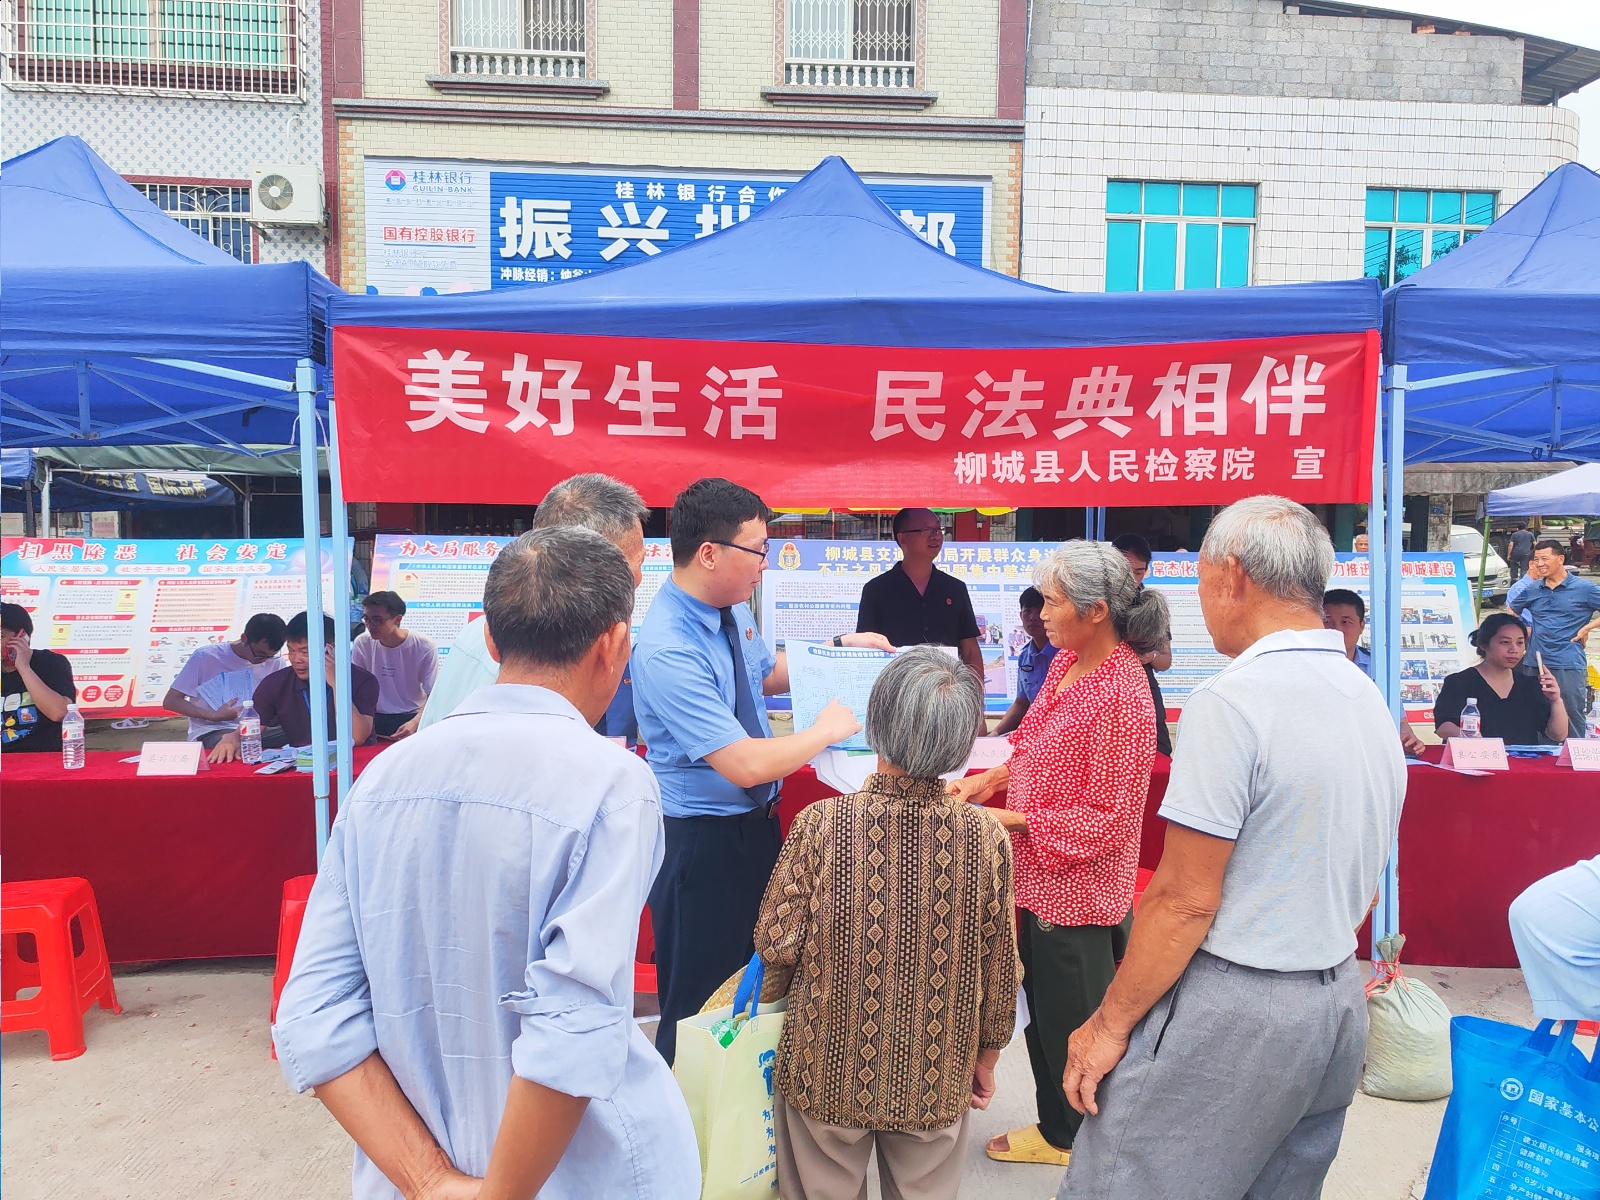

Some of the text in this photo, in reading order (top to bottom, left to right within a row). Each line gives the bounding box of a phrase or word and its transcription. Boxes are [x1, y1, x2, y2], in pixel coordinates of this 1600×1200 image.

[412, 170, 472, 185] 桂林银行
[412, 185, 473, 194] GUILIN BANK
[383, 226, 476, 243] 国有控股银行
[405, 348, 1326, 442] 美好生活 民法典相伴
[953, 446, 1325, 486] 柳城县人民检察院 宣
[18, 542, 287, 561] 扫黑除恶 社会安定
[399, 541, 501, 557] 为大局服务
[35, 565, 103, 573] 人民安居乐业
[1457, 750, 1500, 760] 县公安局
[1528, 1088, 1600, 1133] 国家基本公
